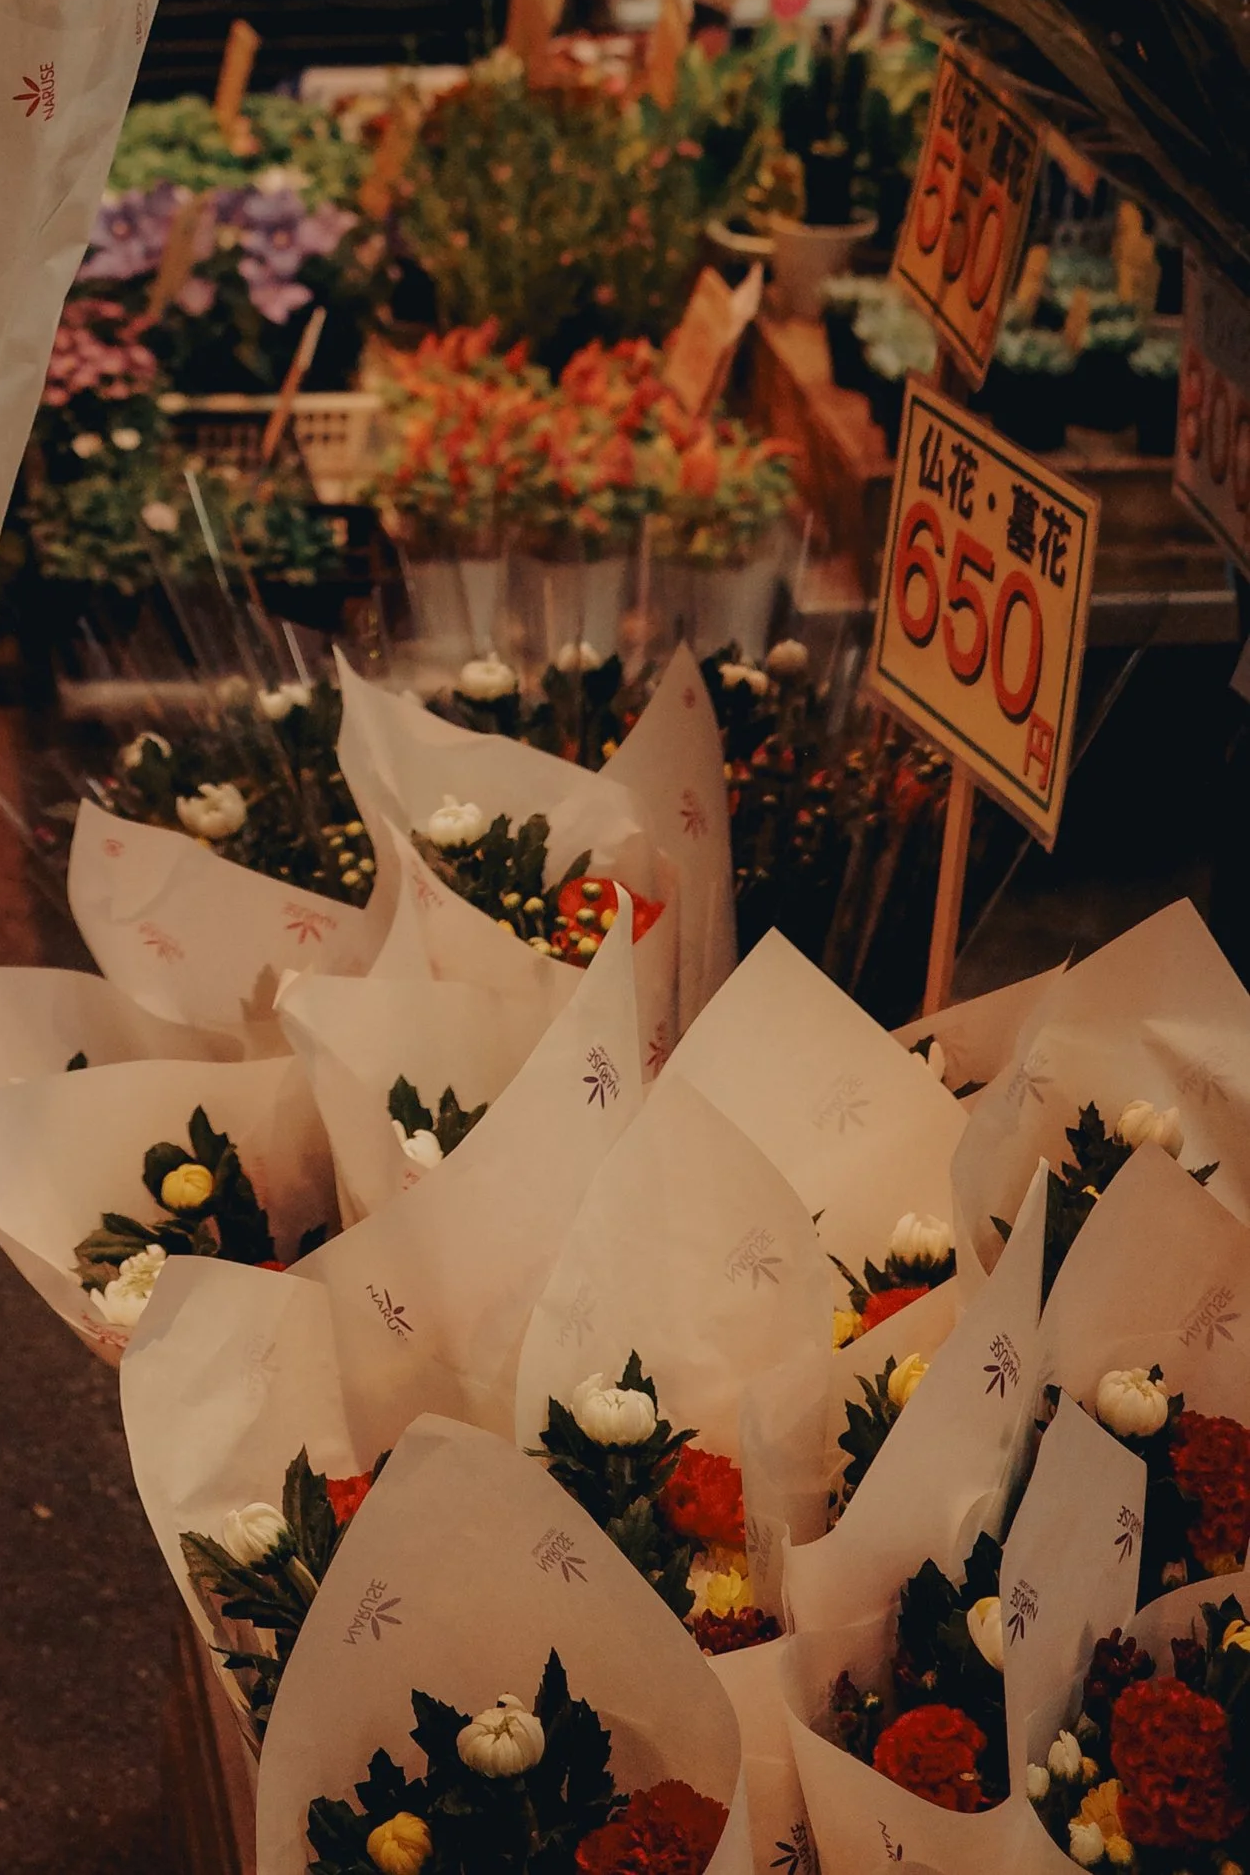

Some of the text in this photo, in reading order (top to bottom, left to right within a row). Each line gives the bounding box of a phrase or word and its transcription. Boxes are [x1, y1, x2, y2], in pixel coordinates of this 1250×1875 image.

[39, 61, 55, 121] NARUSE
[918, 423, 1072, 588] 仏花・墓花
[990, 1335, 1020, 1389] NARUSE
[1009, 1586, 1038, 1622] NARUSE
